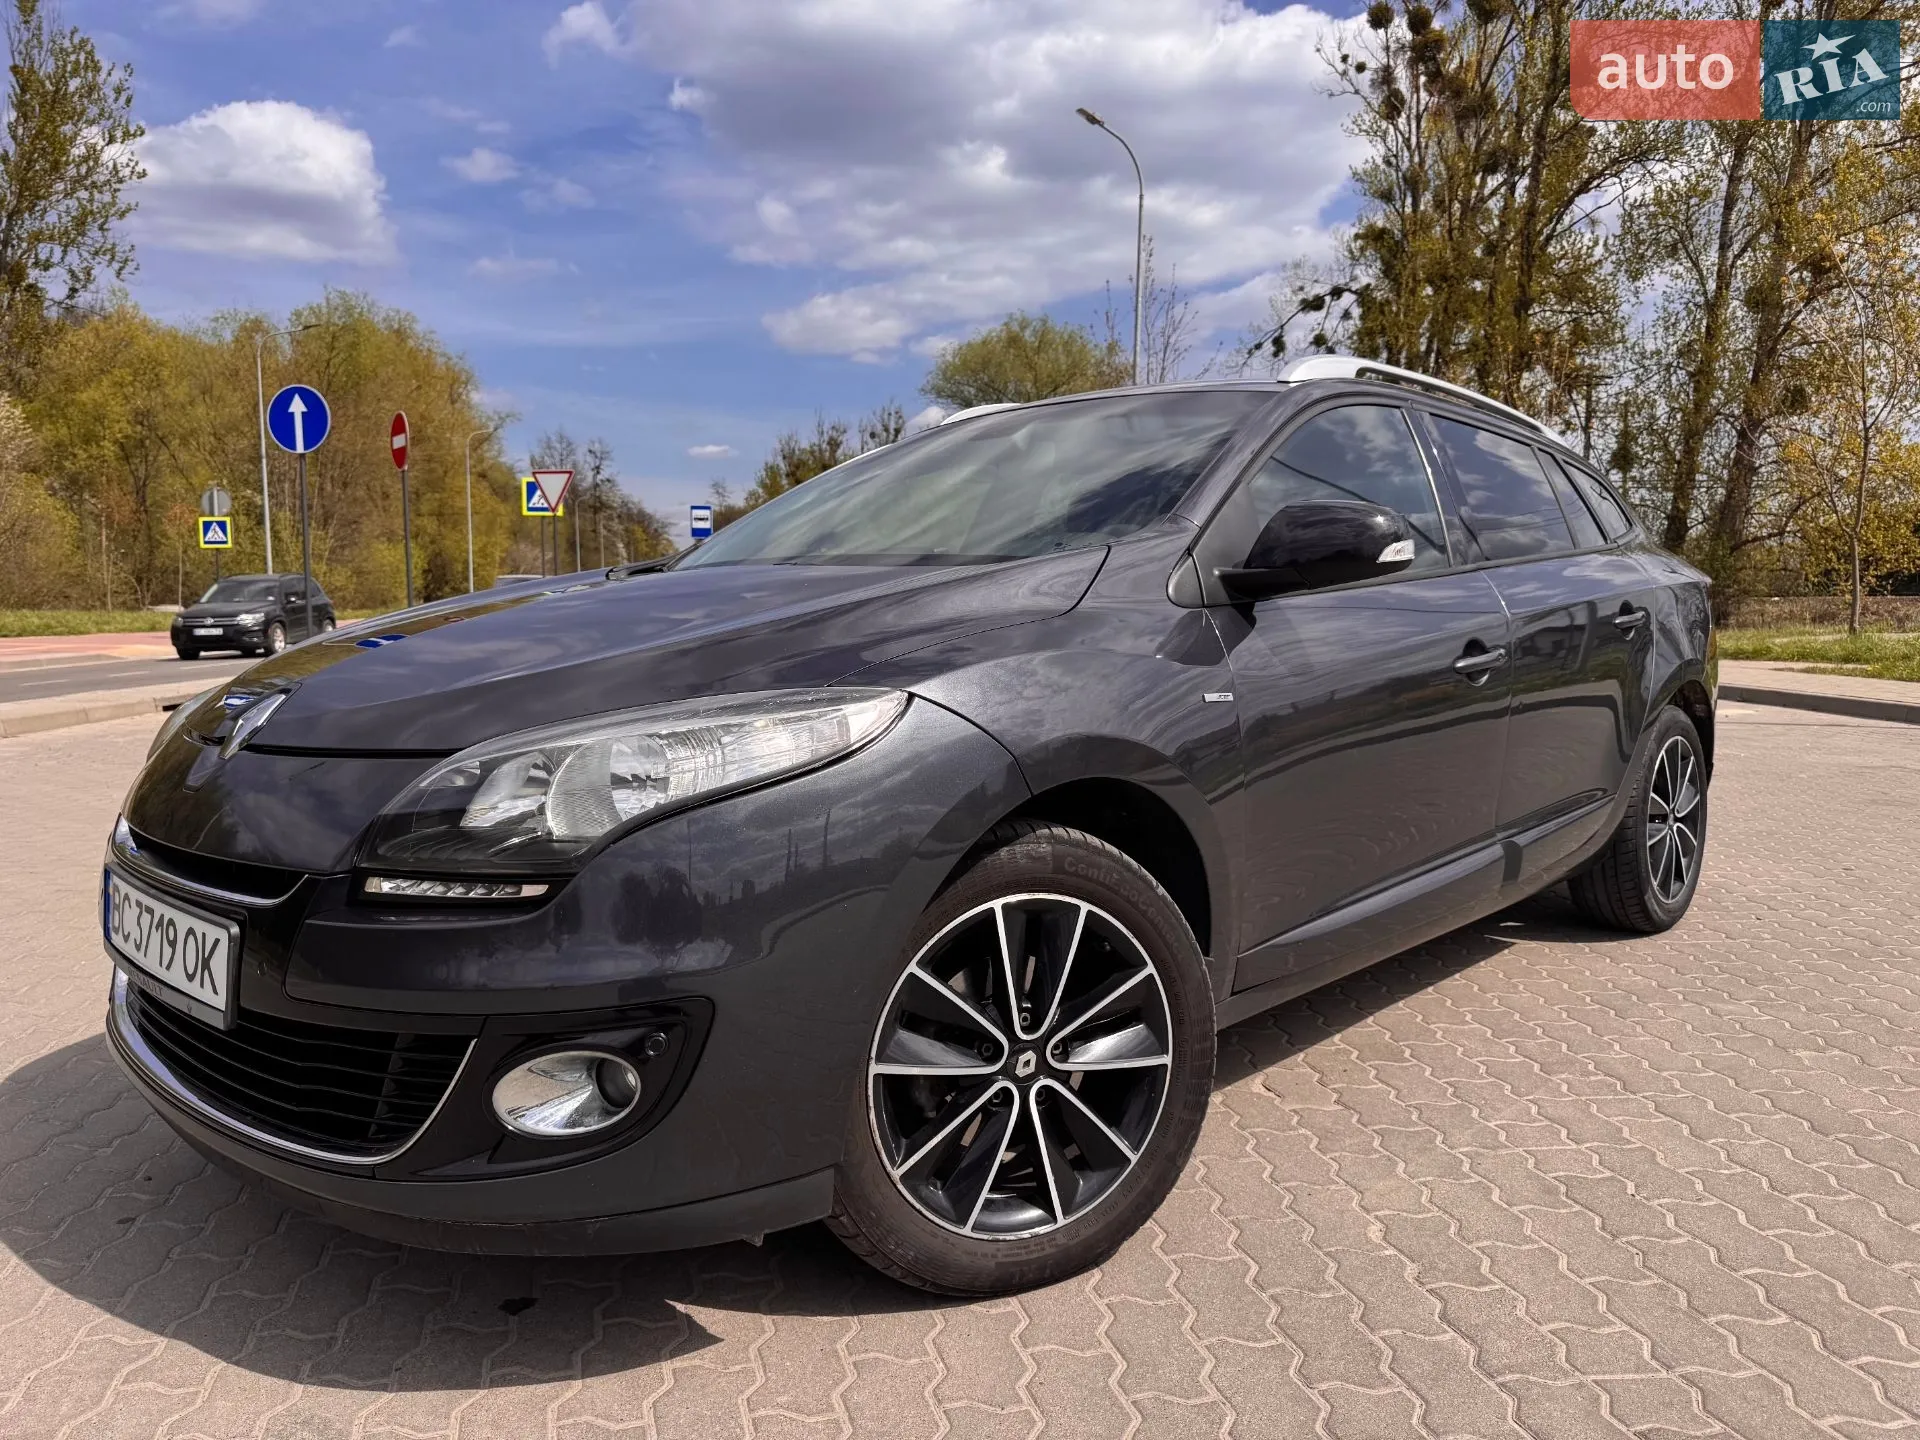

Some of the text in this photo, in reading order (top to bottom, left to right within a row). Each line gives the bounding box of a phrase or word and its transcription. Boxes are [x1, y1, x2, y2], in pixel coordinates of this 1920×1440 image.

[112, 883, 220, 996] BC 3719 OK
